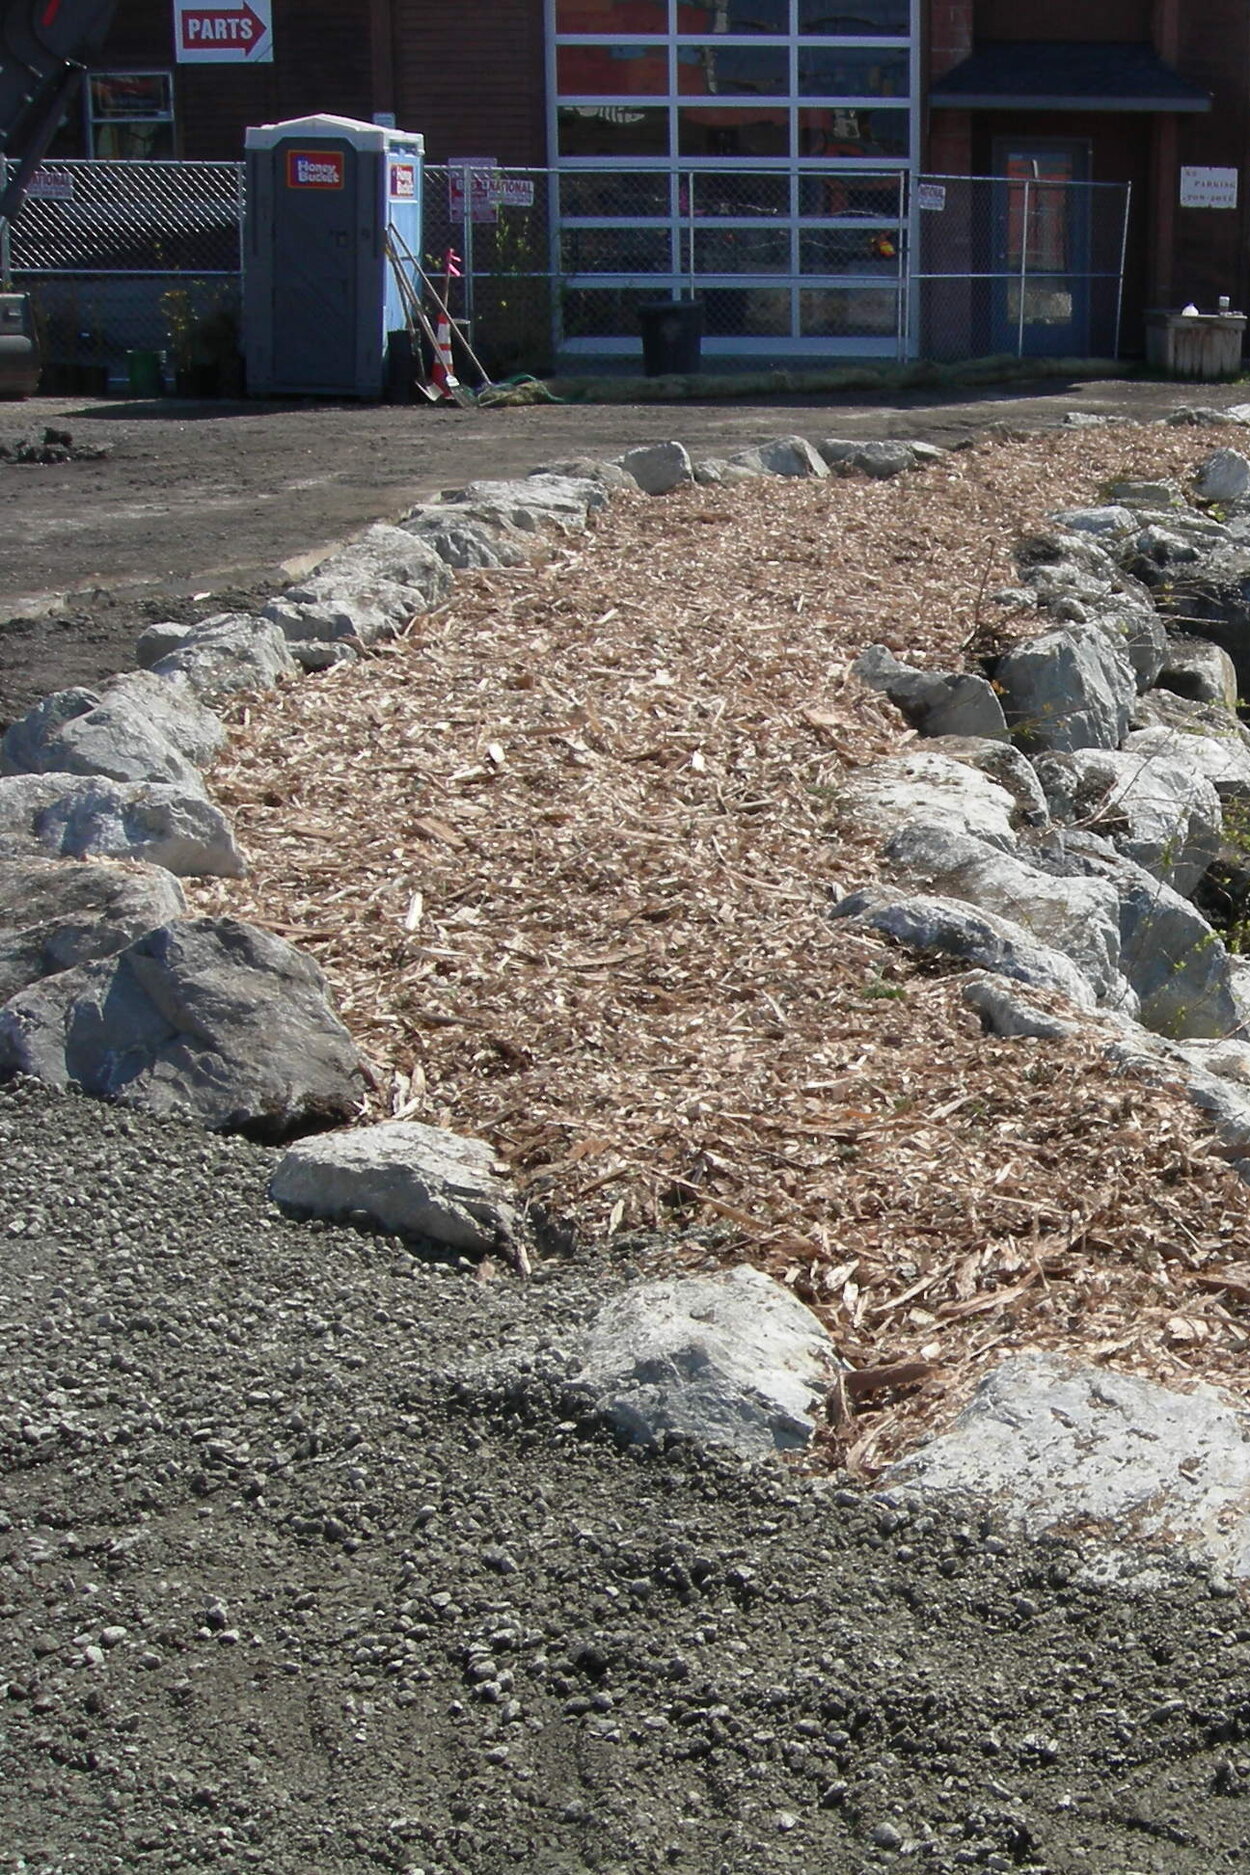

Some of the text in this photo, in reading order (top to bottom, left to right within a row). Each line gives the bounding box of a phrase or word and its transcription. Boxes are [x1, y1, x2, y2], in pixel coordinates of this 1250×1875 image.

[188, 18, 253, 40] PARTS
[297, 160, 336, 176] Honey
[30, 172, 71, 186] ATIONAL
[298, 172, 340, 183] Bucket
[489, 180, 532, 194] NATIONAL
